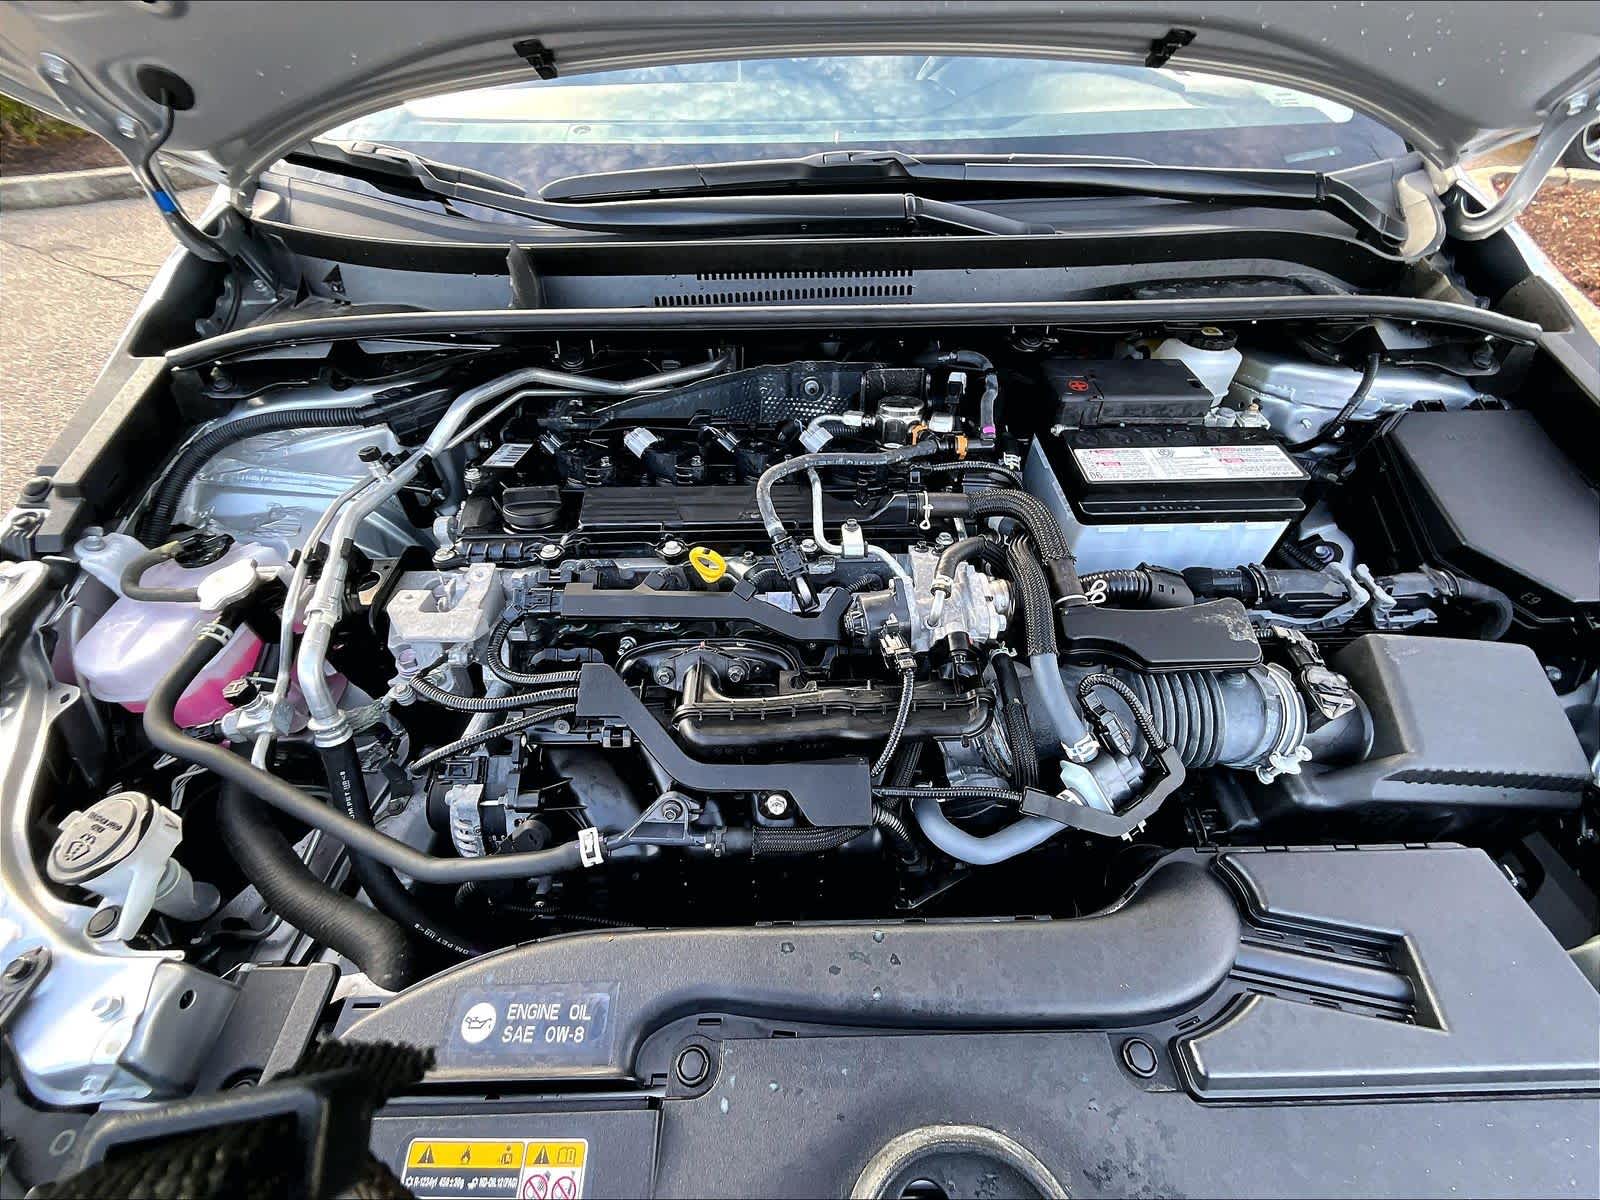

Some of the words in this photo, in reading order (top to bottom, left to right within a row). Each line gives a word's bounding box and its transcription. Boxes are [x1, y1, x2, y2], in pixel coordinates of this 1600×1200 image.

[506, 1003, 560, 1021] ENGINE
[569, 1004, 592, 1021] OIL
[502, 1025, 536, 1043] SAE
[545, 1026, 585, 1043] 0W-8
